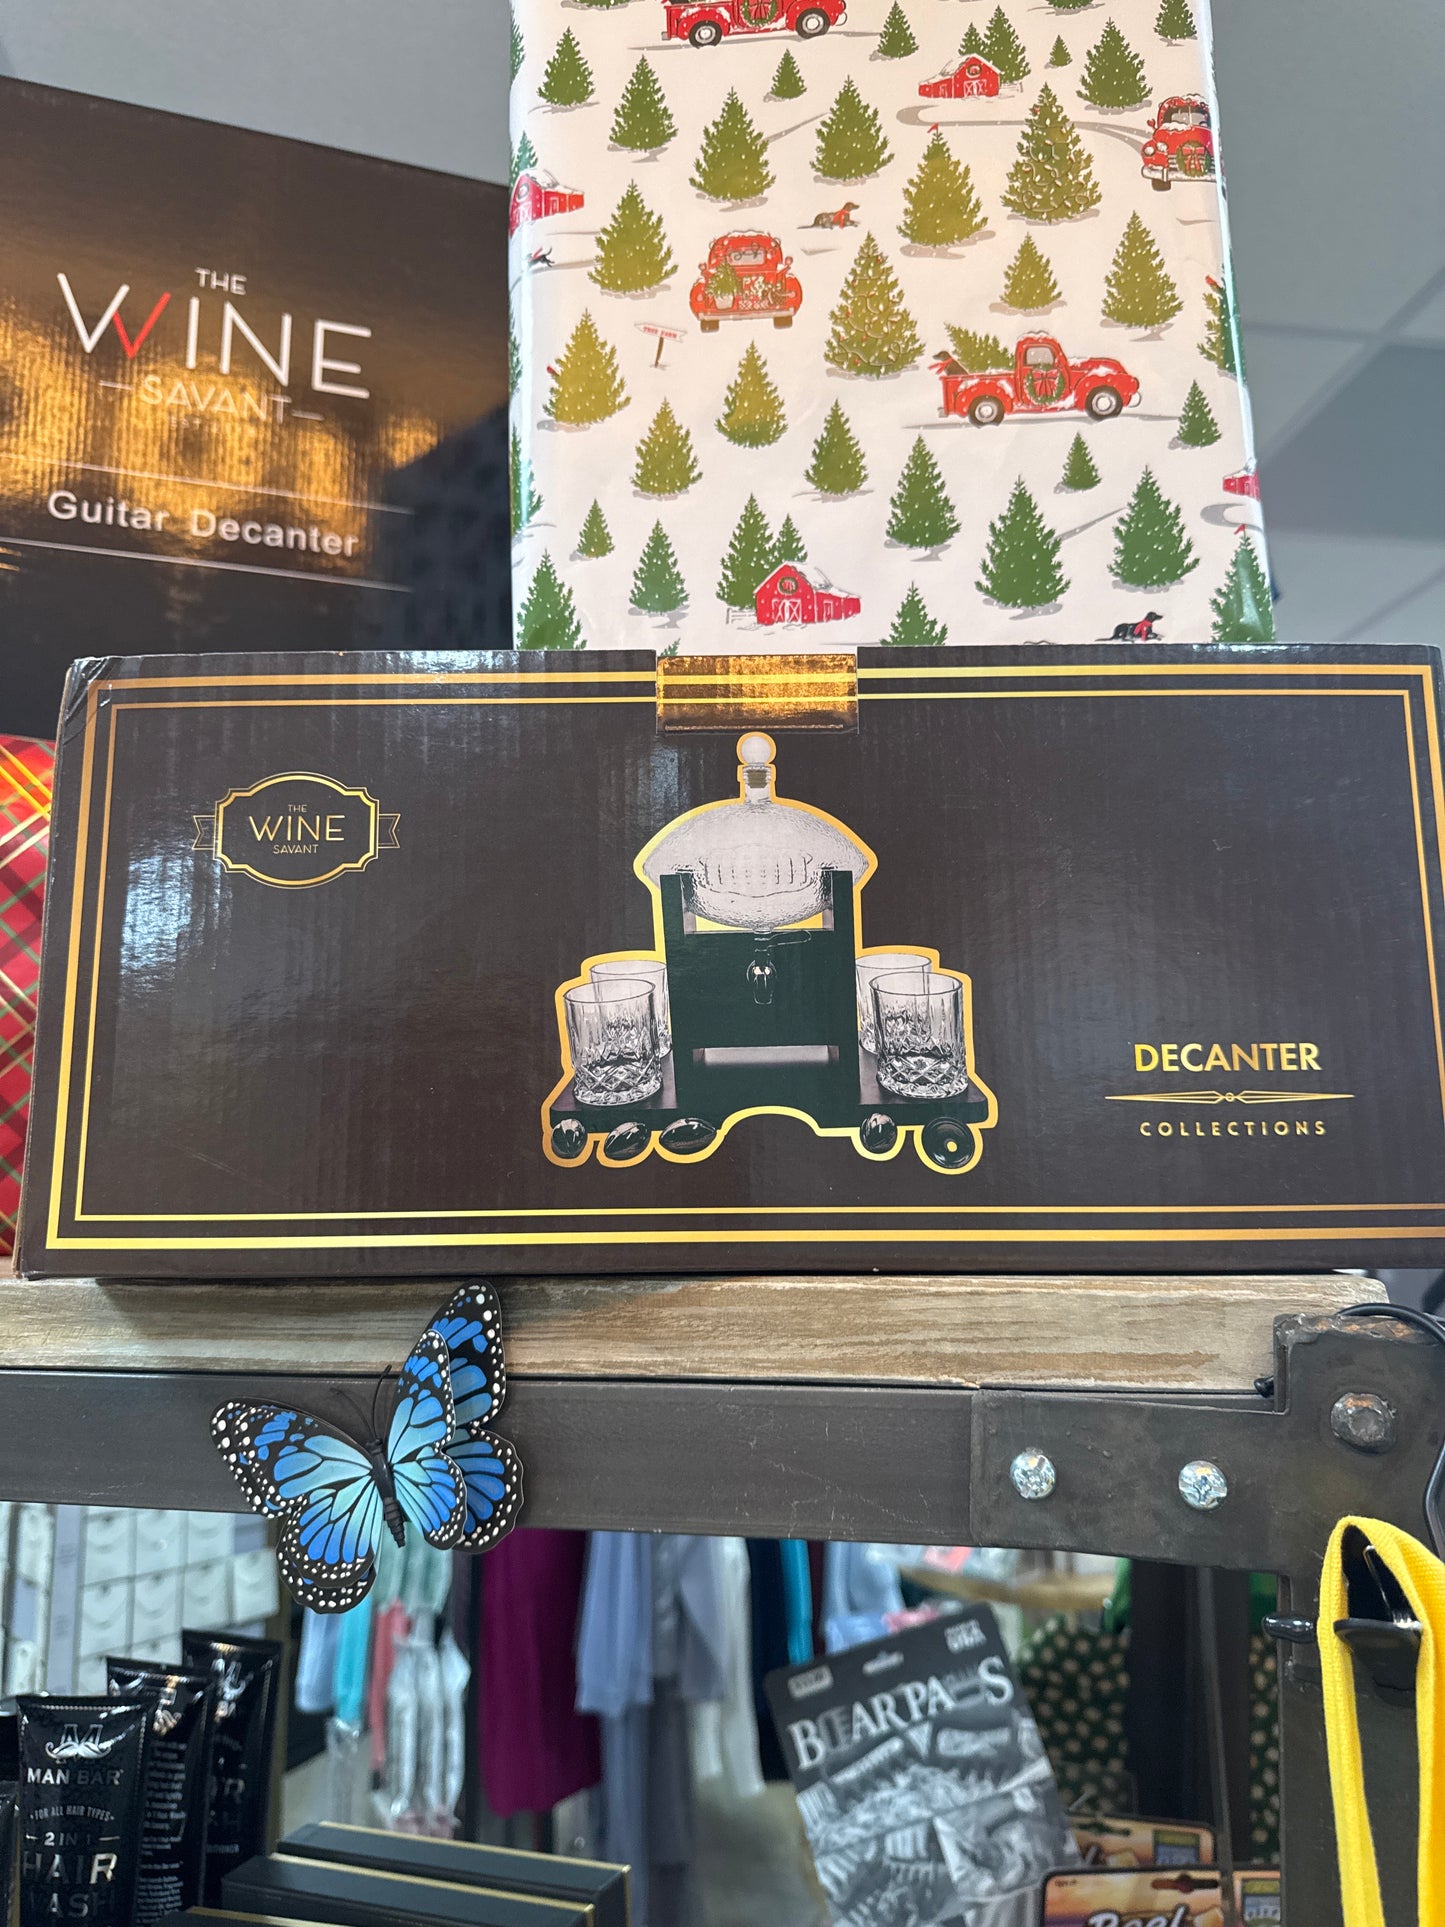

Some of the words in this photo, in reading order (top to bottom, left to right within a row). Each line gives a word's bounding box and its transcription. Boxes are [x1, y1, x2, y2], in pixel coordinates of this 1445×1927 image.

[195, 267, 248, 296] THE
[57, 271, 372, 400] WINE
[140, 374, 293, 424] SAVANT
[47, 489, 169, 533] Guitar
[189, 509, 360, 558] Decanter
[287, 804, 308, 813] THE
[249, 815, 346, 842] WINE
[273, 844, 319, 855] SAVANT
[1134, 1042, 1322, 1072] DECANTER
[1139, 1120, 1326, 1137] COLLECTIONS
[27, 1767, 70, 1785] MAN
[51, 1806, 64, 1816] ALL
[66, 1805, 85, 1816] HAIR
[44, 1831, 55, 1846] 2
[22, 1851, 118, 1884] HAIR
